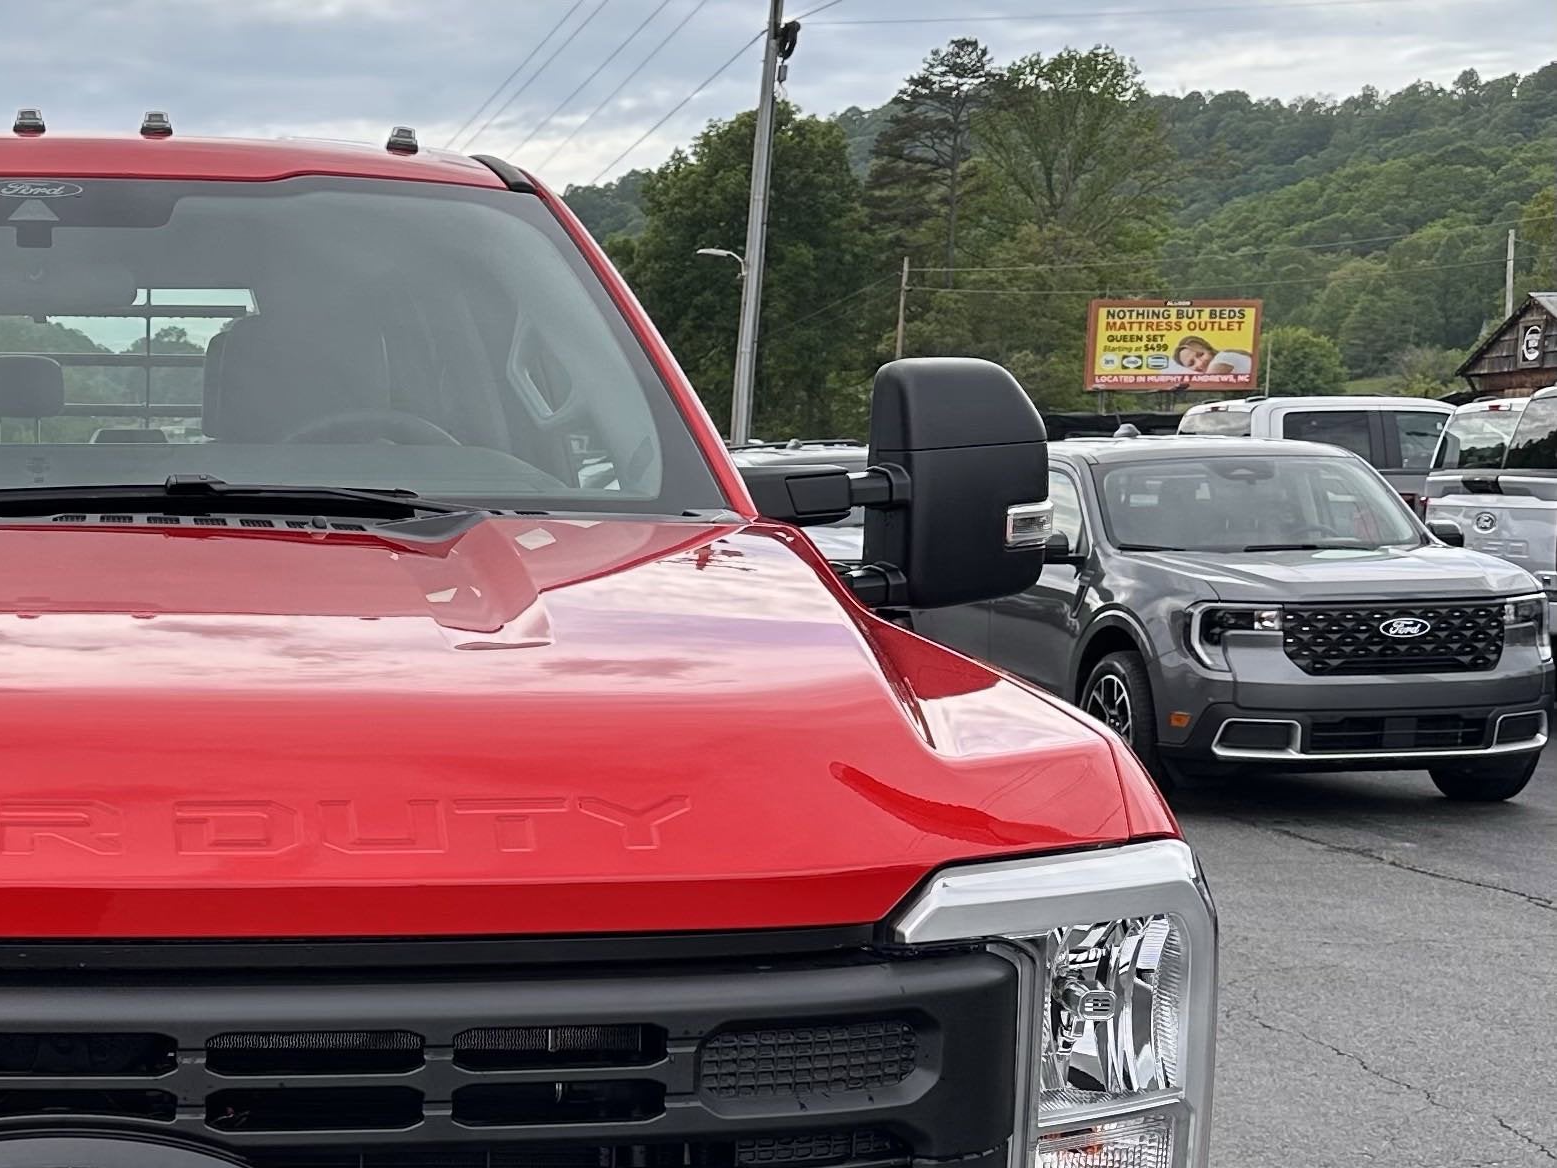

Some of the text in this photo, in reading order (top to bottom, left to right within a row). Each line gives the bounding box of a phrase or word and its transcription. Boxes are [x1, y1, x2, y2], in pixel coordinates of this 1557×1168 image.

[0, 182, 64, 196] Ford
[1106, 309, 1246, 320] NOTHING BUT BEDS
[1105, 320, 1245, 332] MATTRESS OUTLET
[1107, 334, 1166, 343] QUEEN SET
[1143, 343, 1169, 352] $499
[1095, 375, 1135, 384] LOCATED
[1136, 375, 1146, 383] IN
[1147, 375, 1182, 383] MURPHY
[1237, 374, 1250, 383] NC
[1389, 619, 1422, 635] Ford
[173, 795, 692, 855] DUTY
